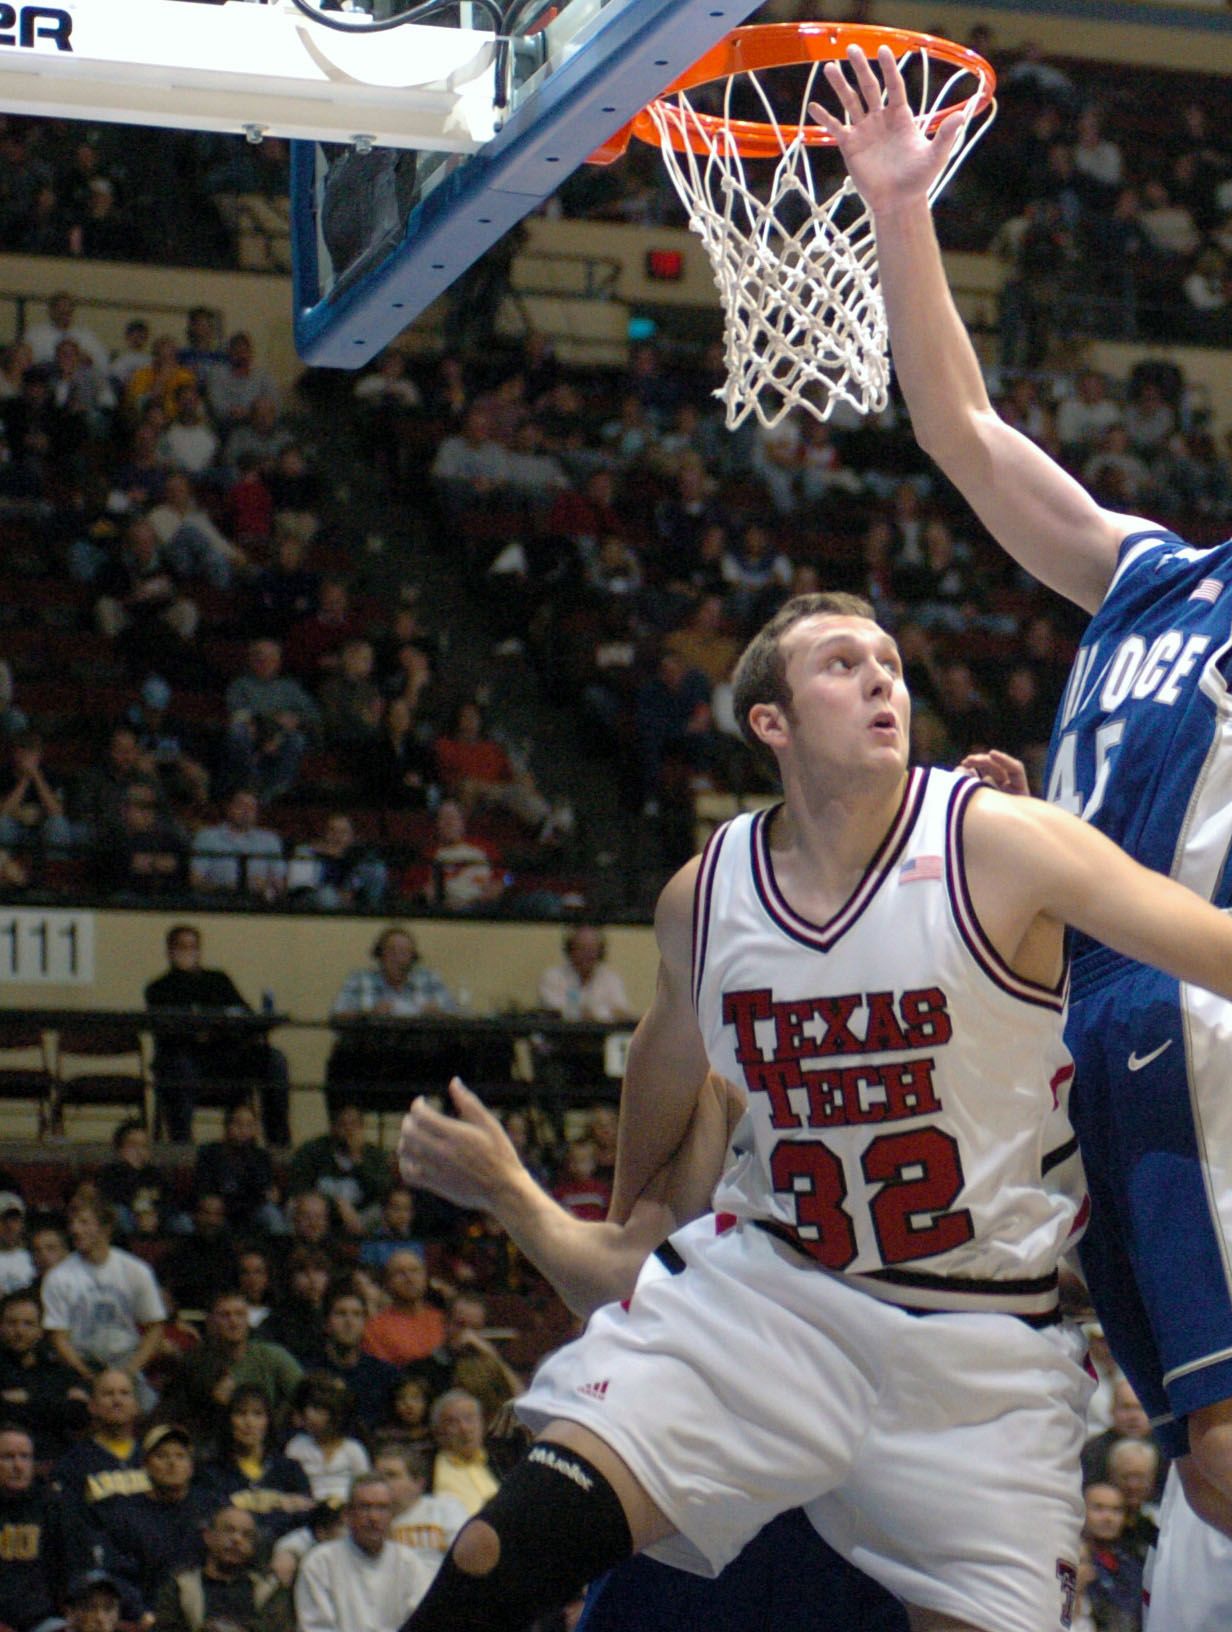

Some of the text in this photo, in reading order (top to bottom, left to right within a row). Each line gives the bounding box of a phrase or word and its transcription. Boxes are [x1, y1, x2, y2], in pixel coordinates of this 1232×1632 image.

[0, 919, 79, 975] 111
[722, 987, 953, 1064] TEXAS
[742, 1057, 943, 1130] TECH
[769, 1125, 975, 1271] 32
